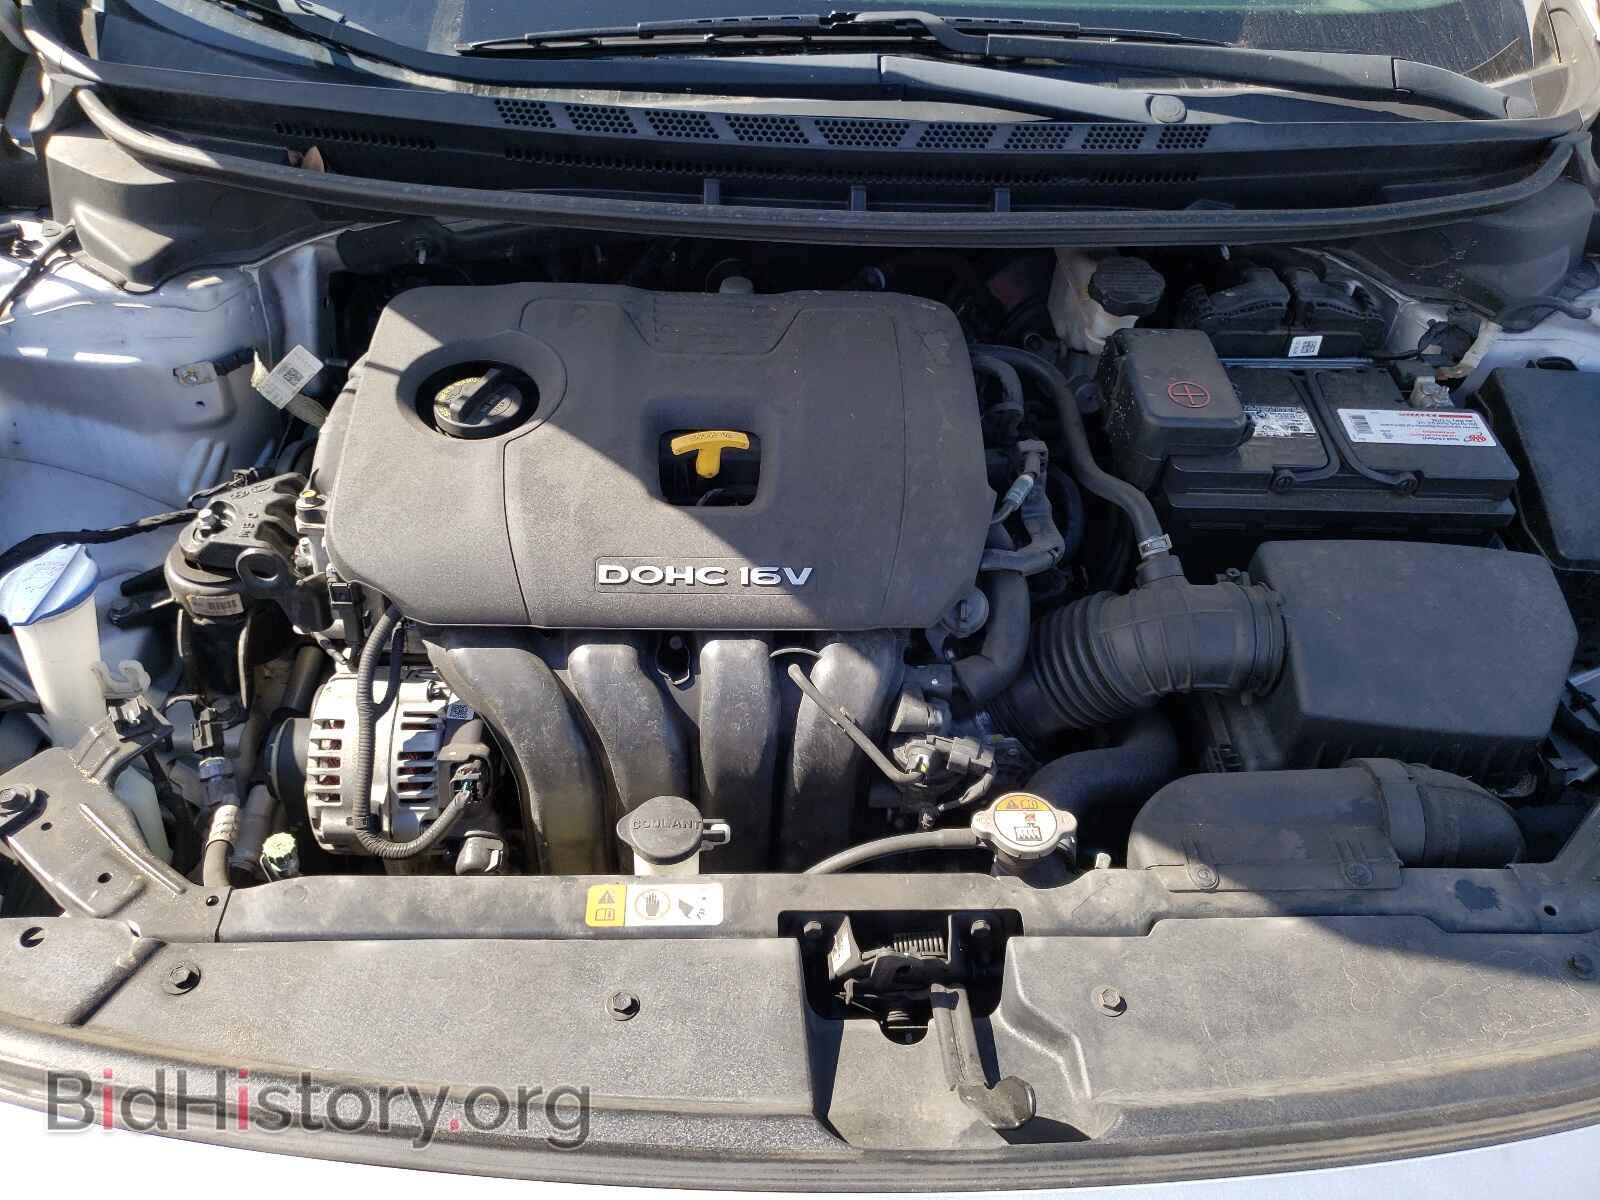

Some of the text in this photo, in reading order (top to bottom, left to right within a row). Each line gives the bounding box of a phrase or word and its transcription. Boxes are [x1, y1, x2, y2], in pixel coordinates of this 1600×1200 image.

[598, 564, 813, 587] DOHC 16V
[632, 815, 702, 832] COOLANT
